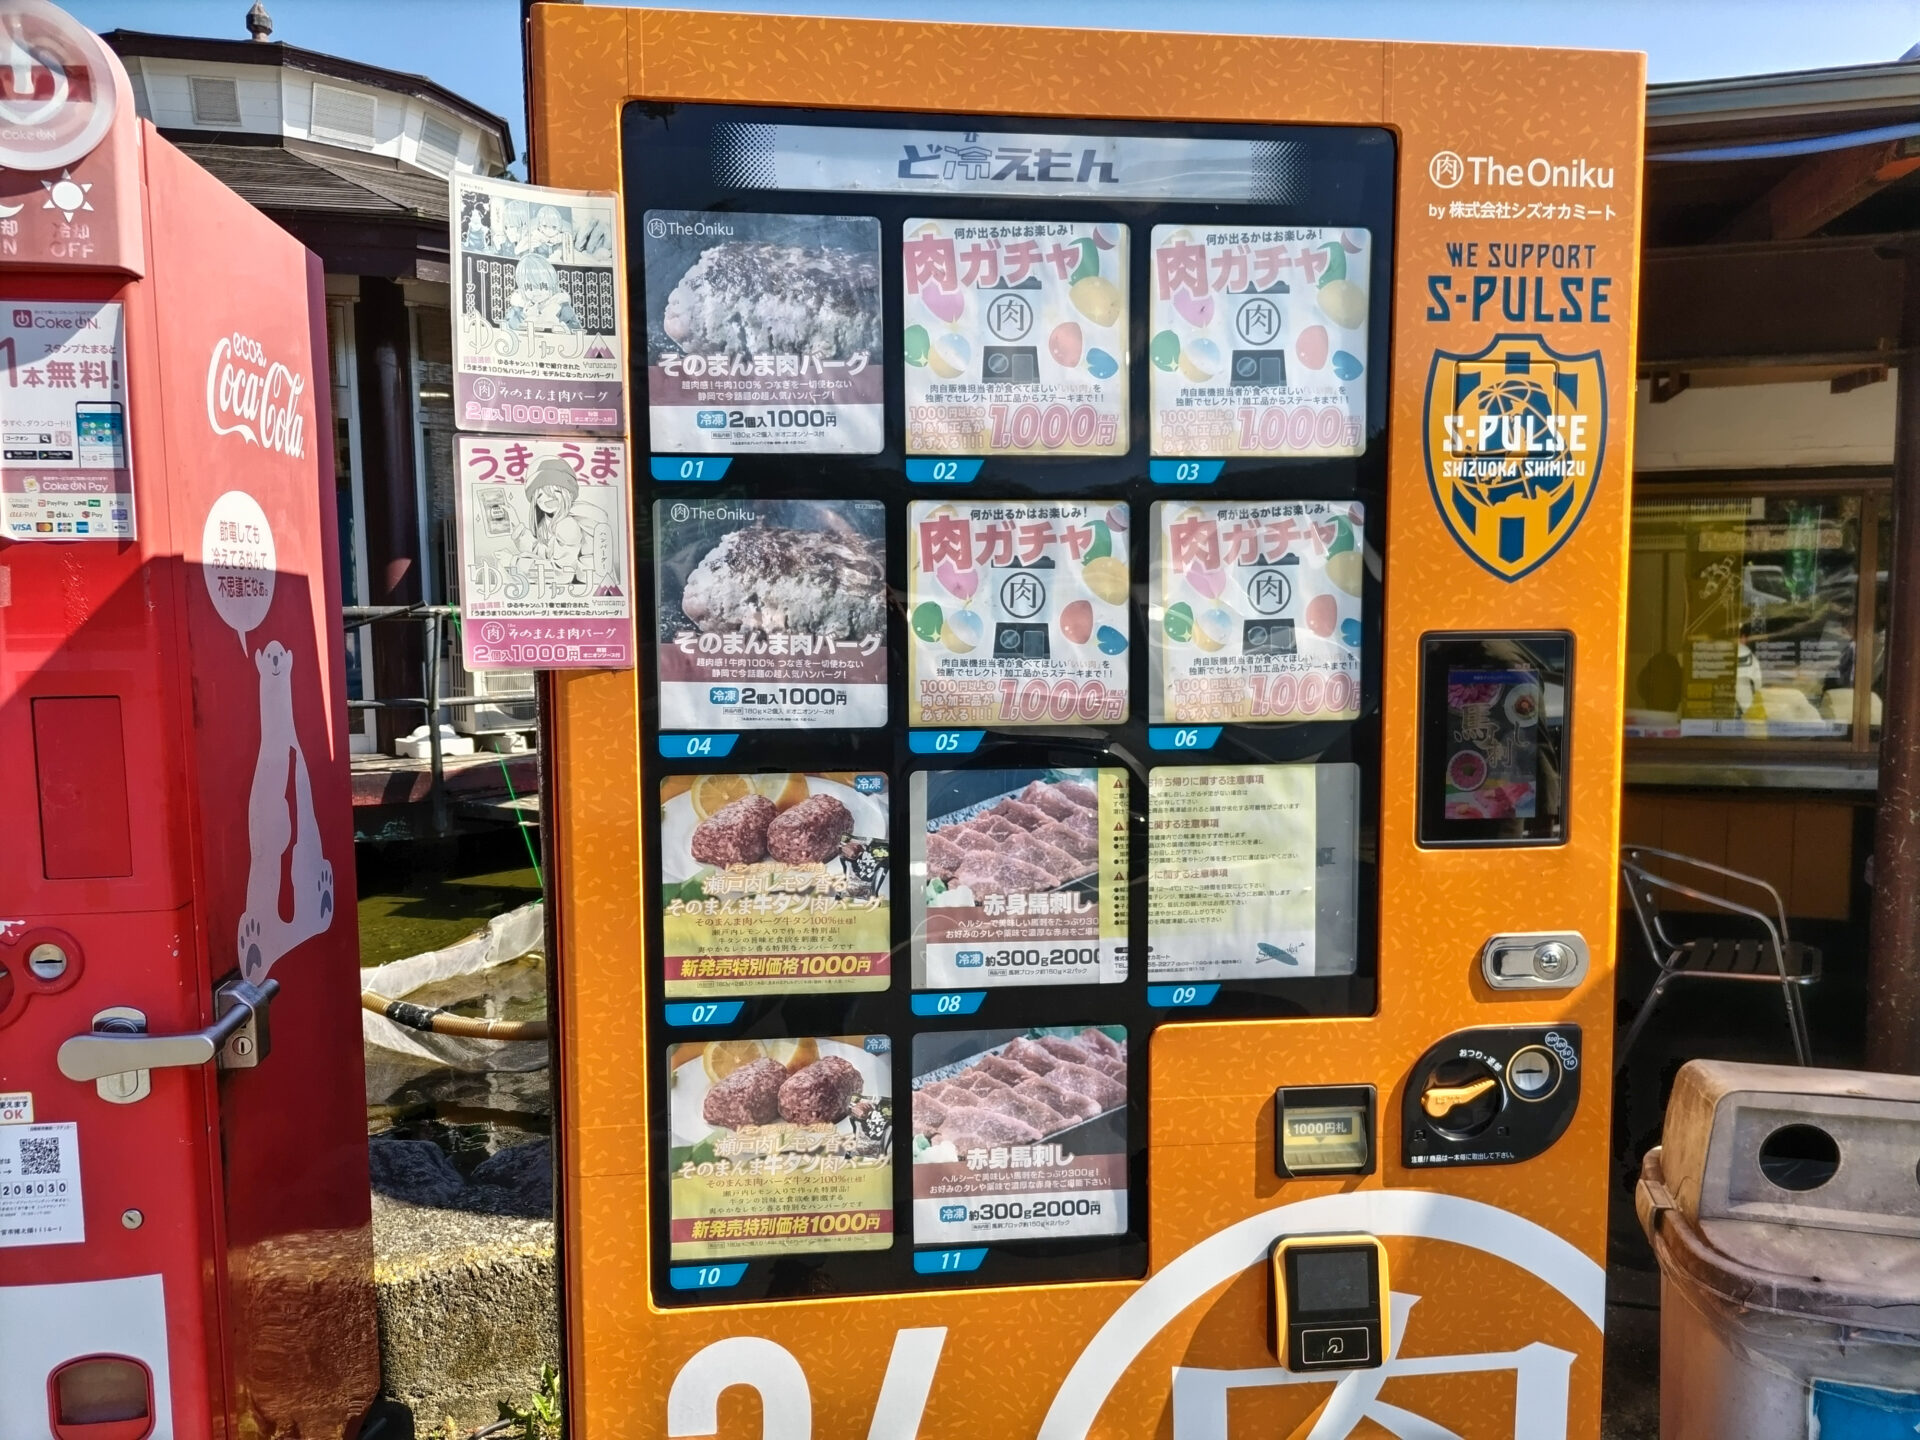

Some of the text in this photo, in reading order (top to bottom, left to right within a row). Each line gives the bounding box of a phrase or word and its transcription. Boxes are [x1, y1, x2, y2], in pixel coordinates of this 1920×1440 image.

[898, 143, 1119, 184] ど冷えもん
[1429, 201, 1616, 221] by 株式会社シズオカミート
[954, 225, 1075, 240] 何が出るかはお楽しみ!
[1206, 229, 1323, 246] 何が出るかはお楽しみ!
[50, 241, 94, 258] OFF
[1446, 243, 1597, 269] WE SUPPORT
[903, 233, 1081, 295] 肉ガチャ
[1156, 241, 1328, 300] 肉ガチャ
[1427, 276, 1612, 322] S-PULSE
[34, 317, 72, 329] Coke
[44, 344, 117, 354] スタンプたまると
[658, 352, 870, 377] そのまんま肉バーグ
[765, 380, 852, 389] つなぎを一切使わない
[207, 337, 305, 459] Coca-Cola
[466, 402, 571, 425] 2個入1000円
[699, 410, 837, 428] 冷凍 2個入1000円
[989, 404, 1118, 448] 1,000円
[1238, 407, 1361, 450] 1,000円
[1443, 415, 1747, 451] S-PULSE
[680, 461, 704, 478] 01
[933, 462, 958, 480] 02
[1176, 463, 1199, 481] 03
[1443, 461, 1746, 477] SHIZUOKA SHIMIZU
[42, 481, 69, 491] Coke
[88, 481, 109, 493] Pay
[971, 508, 1087, 521] 何が出るかはお楽しみ!
[1217, 504, 1331, 520] 何が出るかはお楽しみ!
[12, 523, 32, 531] VISA
[219, 519, 260, 544] 節電しても
[919, 515, 1092, 572] 肉ガチャ
[1169, 517, 1336, 574] 肉ガチャ
[211, 547, 267, 571] 冷えてるなんて
[674, 631, 882, 656] そのまんま肉バーグ
[473, 645, 580, 662] 2個入1000円
[778, 659, 864, 669] つなぎを一切使わない
[712, 670, 847, 680] 静岡で今話題の超人気ハンバーグ!
[713, 688, 847, 705] 冷凍 2個入1000円
[999, 679, 1124, 721] 1,000円
[686, 737, 711, 755] 04
[936, 734, 959, 751] 05
[1174, 730, 1197, 747] 06
[857, 778, 881, 790] 冷凍
[983, 891, 1093, 915] 赤身馬刺し
[681, 956, 871, 978] 新発売特別価格1000円
[959, 954, 981, 965] 冷凍
[937, 995, 962, 1012] 08
[1173, 987, 1196, 1004] 09
[692, 1005, 717, 1023] 07
[867, 1038, 890, 1051] 冷凍
[4, 1109, 23, 1120] OK
[1293, 1121, 1347, 1135] 1000円札
[966, 1144, 1075, 1170] 赤身馬刺し
[942, 1200, 1101, 1221] 冷凍 約300g2000円
[691, 1213, 880, 1239] 新発売特別価格1000円
[941, 1252, 961, 1269] 11
[699, 1267, 720, 1285] 10
